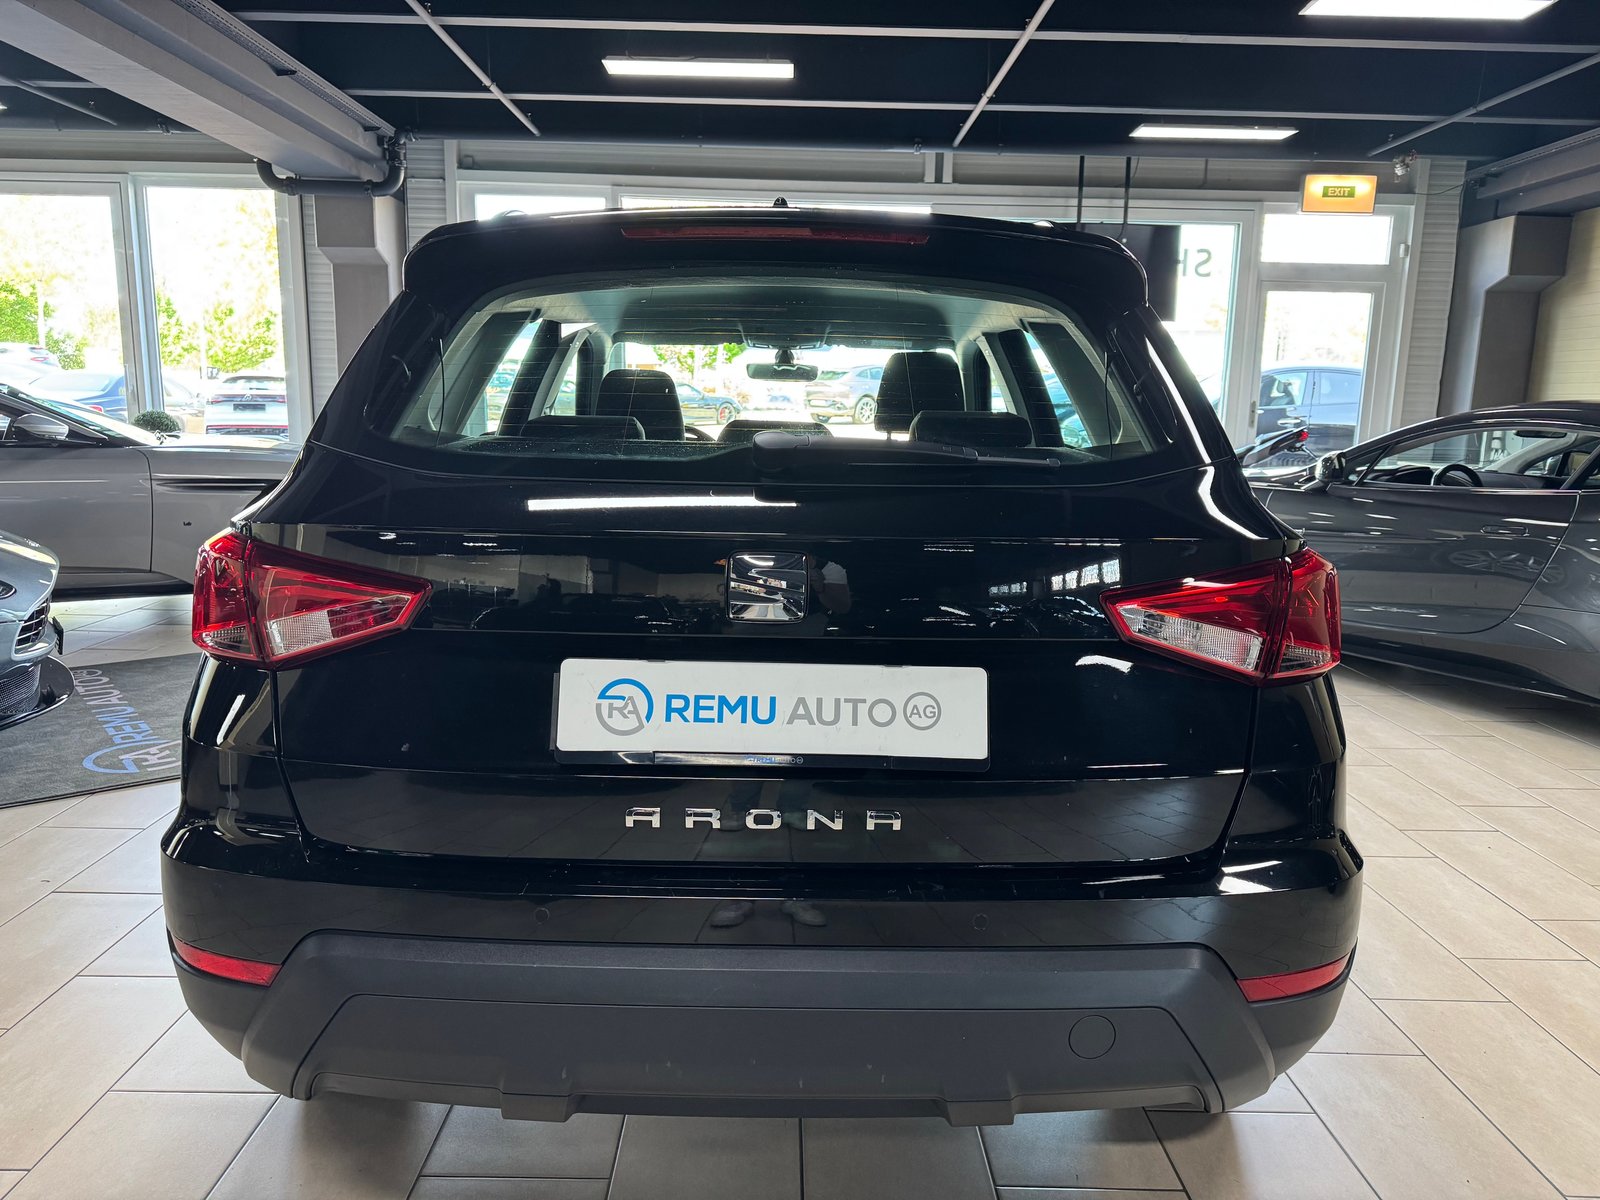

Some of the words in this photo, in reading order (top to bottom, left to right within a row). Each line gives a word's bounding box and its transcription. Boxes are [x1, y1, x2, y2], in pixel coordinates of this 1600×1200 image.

[1327, 187, 1351, 196] EXIT
[74, 676, 128, 705] AUTO
[91, 706, 159, 744] REMU
[665, 694, 776, 725] REMU
[786, 697, 897, 727] AUTO
[908, 704, 937, 719] AG
[625, 807, 901, 831] ARONA
